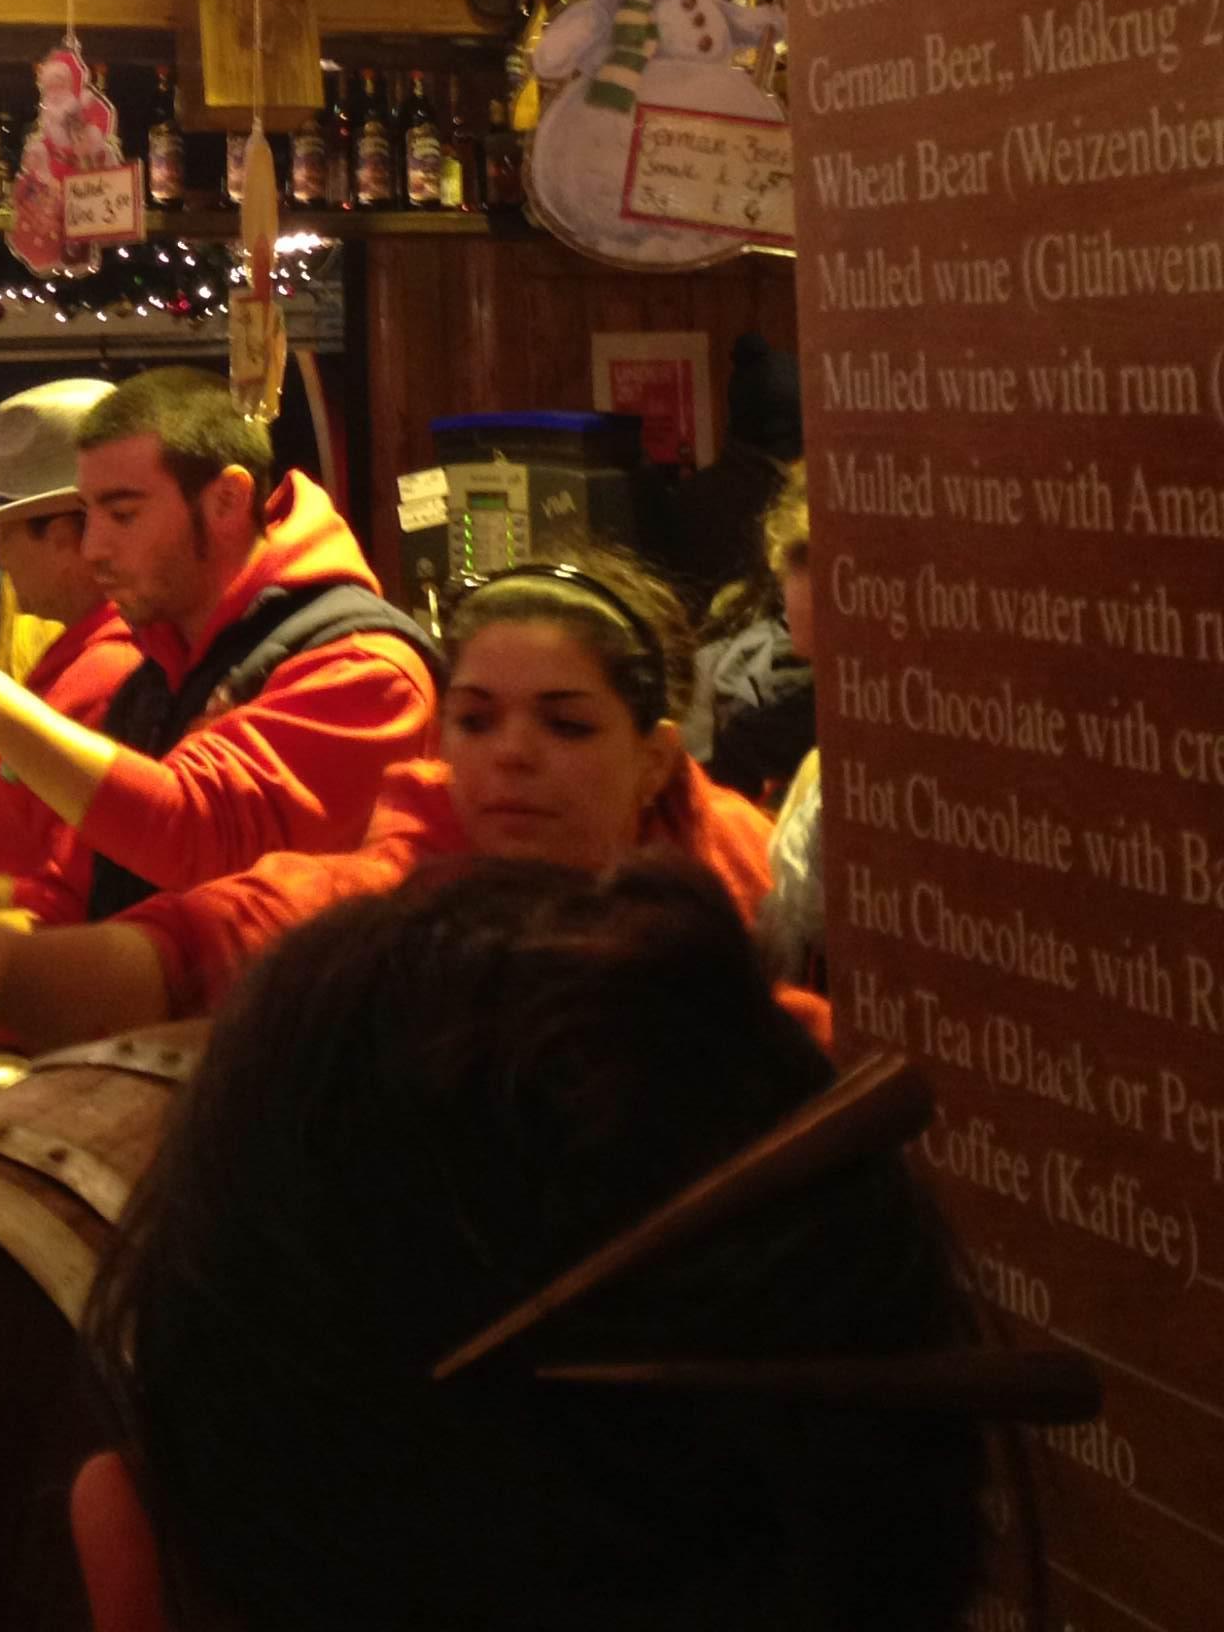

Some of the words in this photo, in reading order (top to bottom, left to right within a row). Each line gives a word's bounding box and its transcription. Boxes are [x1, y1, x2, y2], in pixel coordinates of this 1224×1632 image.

[808, 55, 917, 115] German
[812, 150, 907, 210] Wheat
[916, 139, 993, 201] Bear
[818, 245, 923, 313] Mulled
[933, 239, 1012, 304] wine
[821, 349, 929, 413] Mulled
[936, 347, 1018, 413] wine
[1027, 345, 1107, 414] with
[1119, 361, 1200, 416] rum
[826, 450, 934, 520] Mulled
[943, 456, 1026, 526] wine
[1032, 458, 1114, 532] with
[1123, 463, 1224, 538] Ama
[831, 553, 909, 641] Grog
[915, 562, 982, 640] (hot
[988, 582, 1089, 647] water
[1094, 579, 1184, 659] with
[837, 655, 893, 726] Hot
[899, 665, 1068, 758] Chocolate
[1076, 696, 1161, 774] with
[842, 758, 899, 832] Hot
[904, 772, 1074, 873] Chocolate
[1082, 815, 1169, 897] with
[847, 863, 904, 939] Hot
[910, 879, 1078, 992] Chocolate
[1089, 936, 1175, 1022] with
[1186, 953, 1224, 1034] R
[851, 969, 909, 1049] Hot
[912, 987, 973, 1071] Tea
[982, 1012, 1098, 1116] (Black
[1107, 1074, 1149, 1133] or
[1041, 1147, 1201, 1291] (Kaffee)
